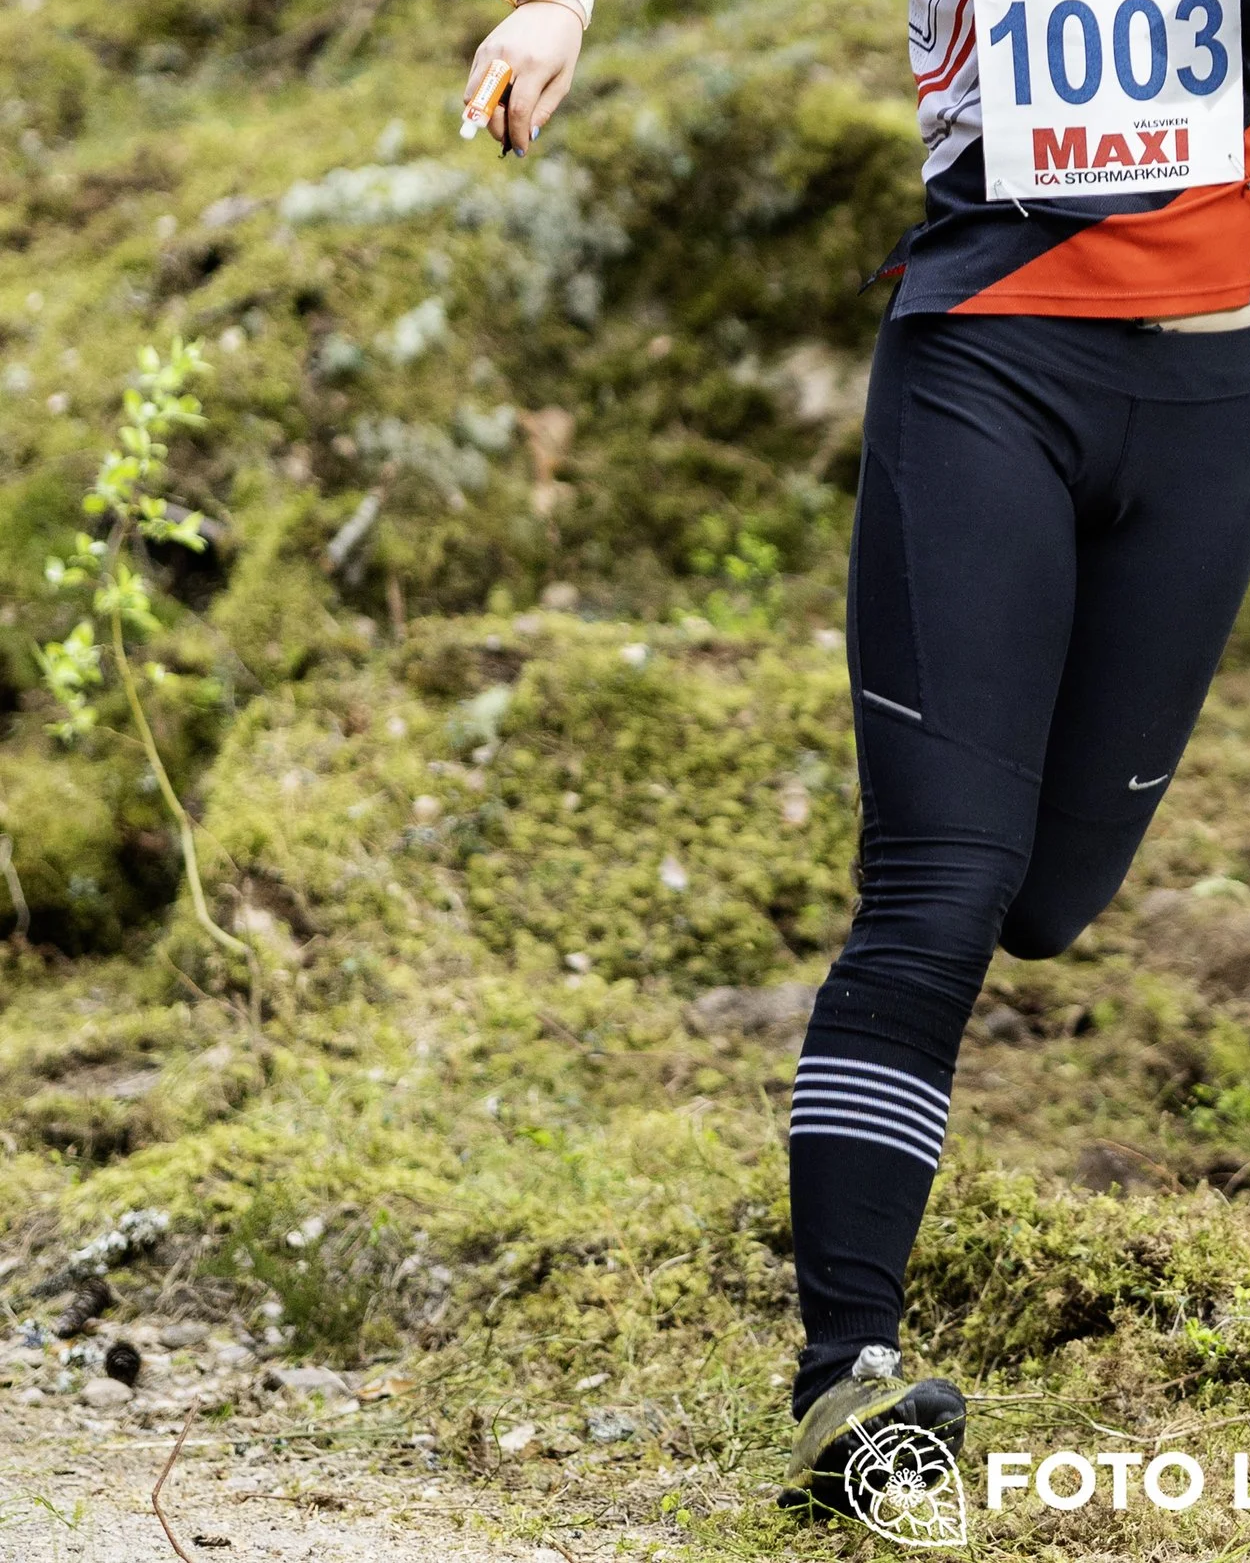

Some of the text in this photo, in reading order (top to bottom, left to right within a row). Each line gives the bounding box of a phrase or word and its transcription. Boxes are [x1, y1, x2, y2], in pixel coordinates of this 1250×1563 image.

[1133, 117, 1189, 129] VÄLSVIKEN
[1032, 126, 1190, 171] MAXI
[1034, 164, 1190, 185] ICA STORMARKNAD
